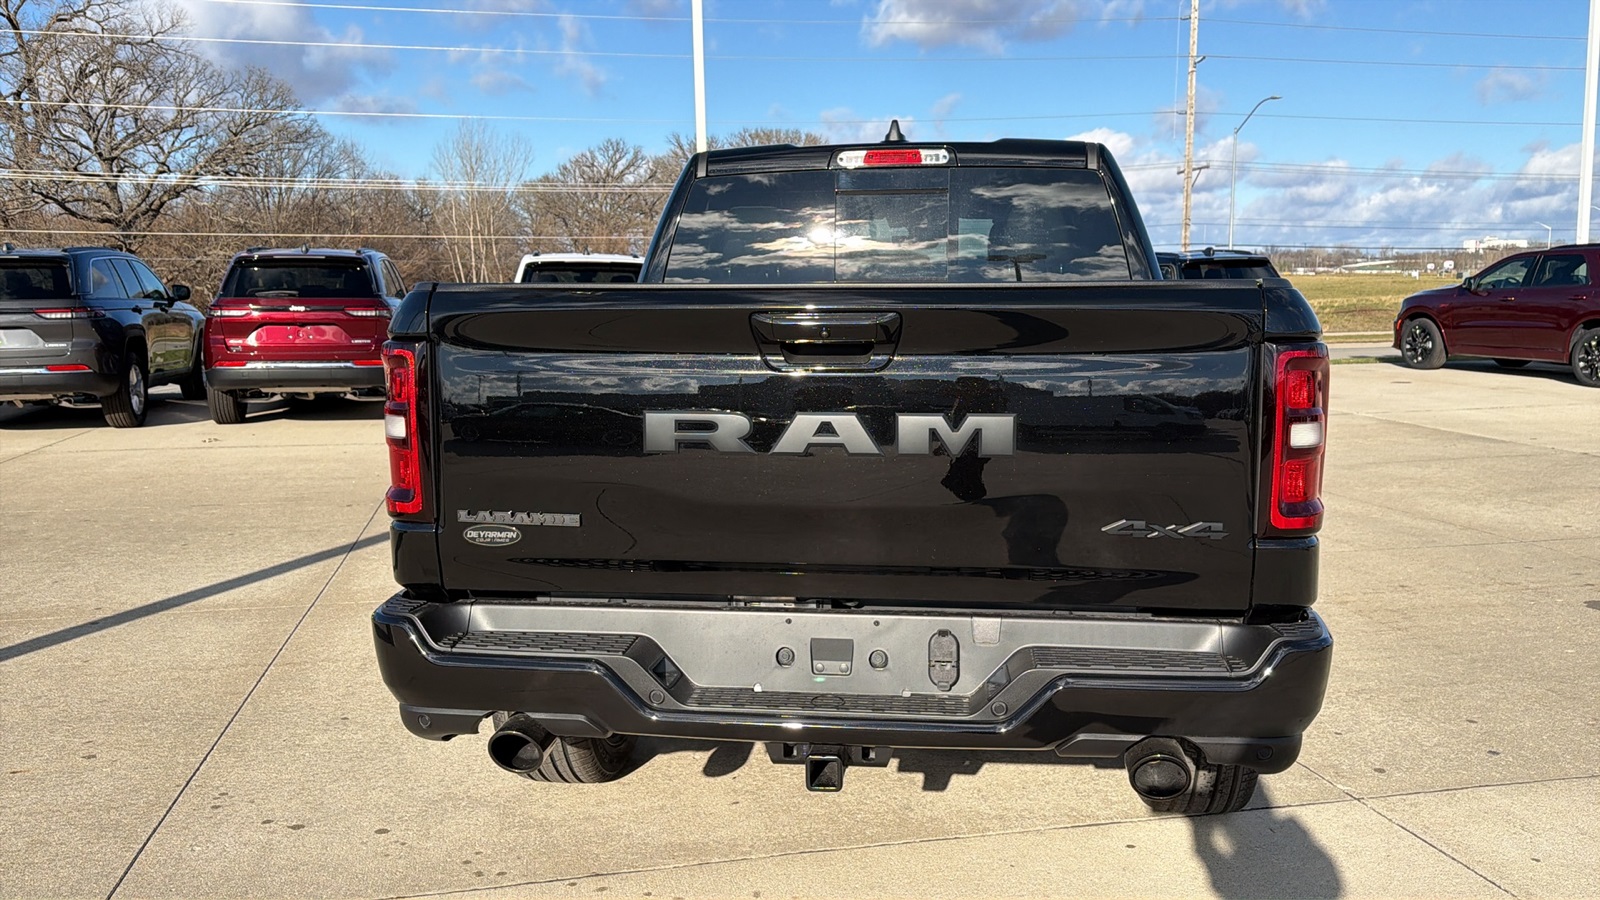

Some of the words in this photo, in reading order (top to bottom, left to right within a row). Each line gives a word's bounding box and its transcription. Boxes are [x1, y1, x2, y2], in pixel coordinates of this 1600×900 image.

[643, 410, 1018, 457] RAM
[457, 509, 582, 527] LARAMIE
[467, 530, 517, 538] DEYARMAN
